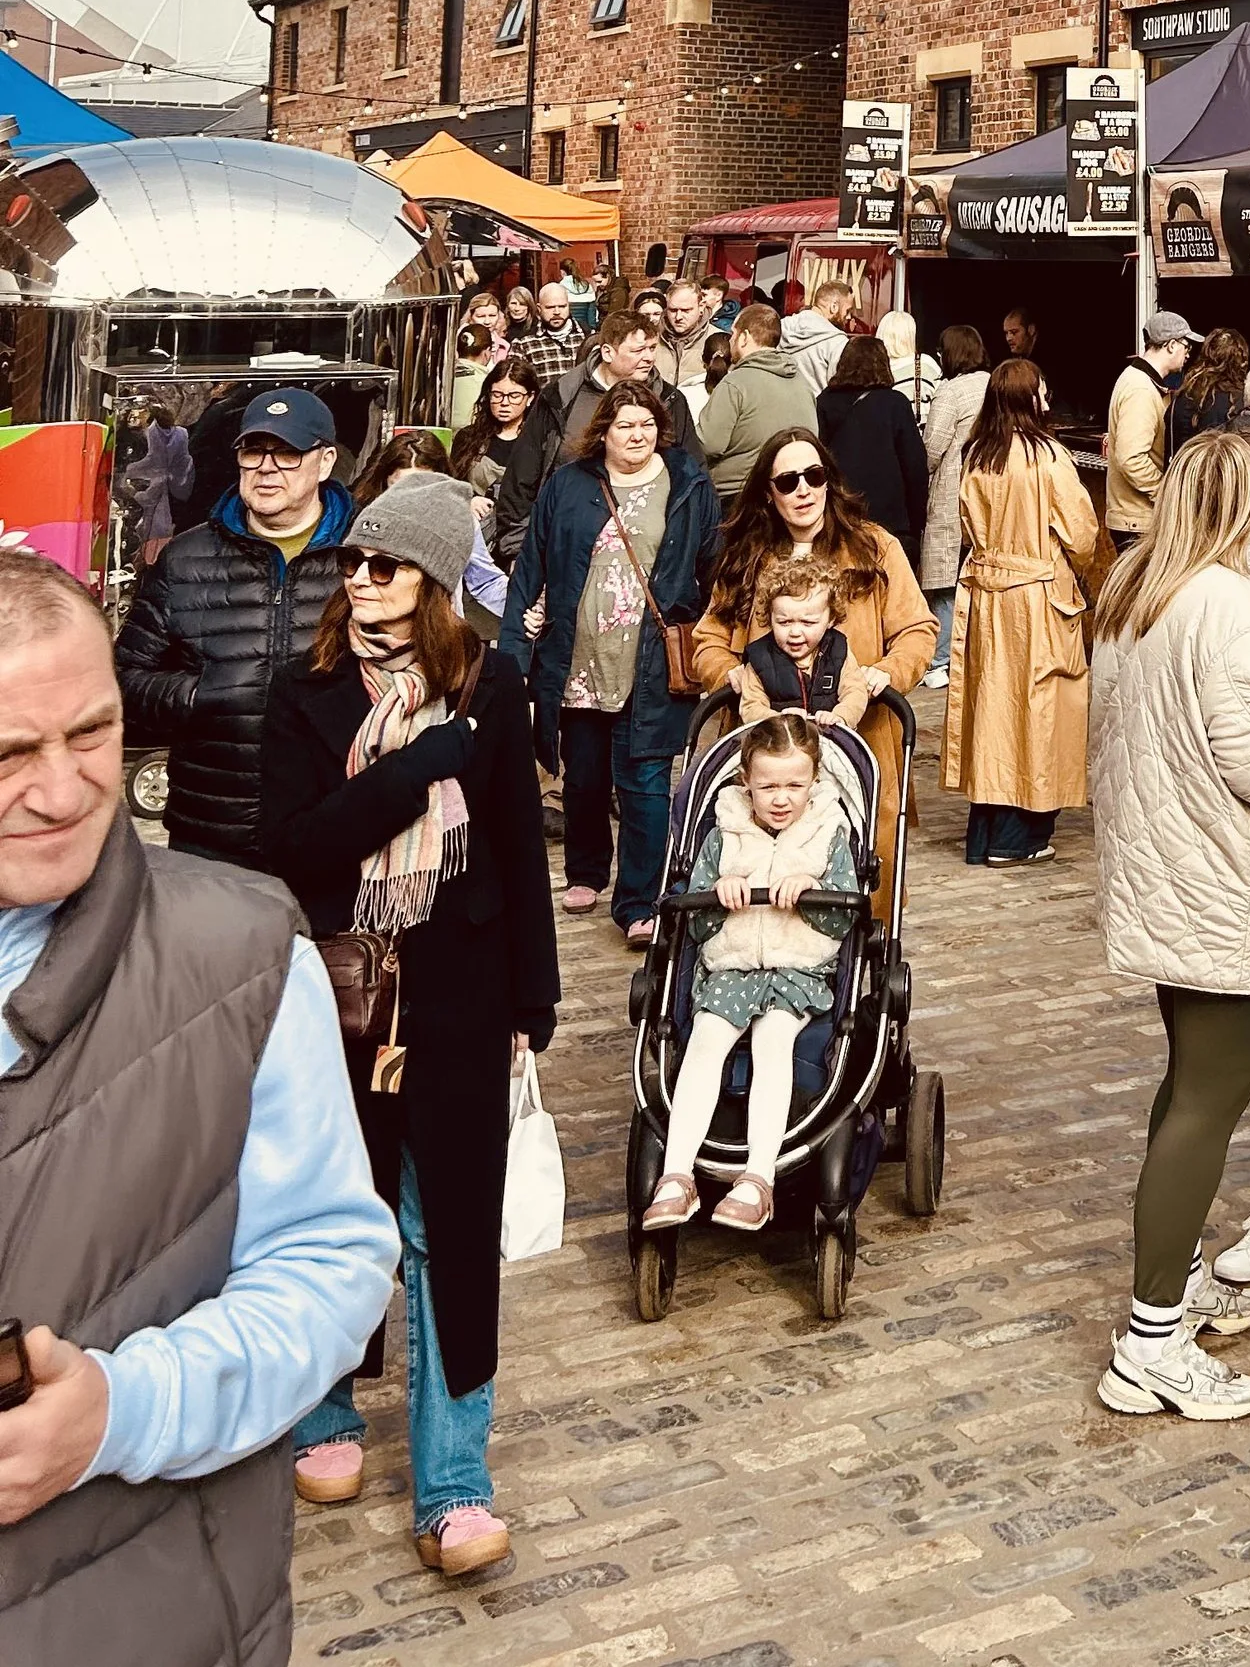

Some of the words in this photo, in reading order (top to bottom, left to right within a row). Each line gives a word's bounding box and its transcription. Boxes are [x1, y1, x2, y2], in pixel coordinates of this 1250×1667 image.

[1143, 12, 1194, 41] SOUTHPAW
[1196, 7, 1231, 34] STUDIO
[1104, 126, 1129, 137] £5.00
[1075, 167, 1103, 179] £4.00
[847, 183, 872, 193] £4.00
[1100, 200, 1128, 212] £2.50
[866, 212, 891, 222] £2.50
[957, 201, 994, 230] ARTISAN
[994, 194, 1068, 234] SAUSAG
[1167, 226, 1213, 243] GEORDIE
[1168, 242, 1215, 259] BANGERS
